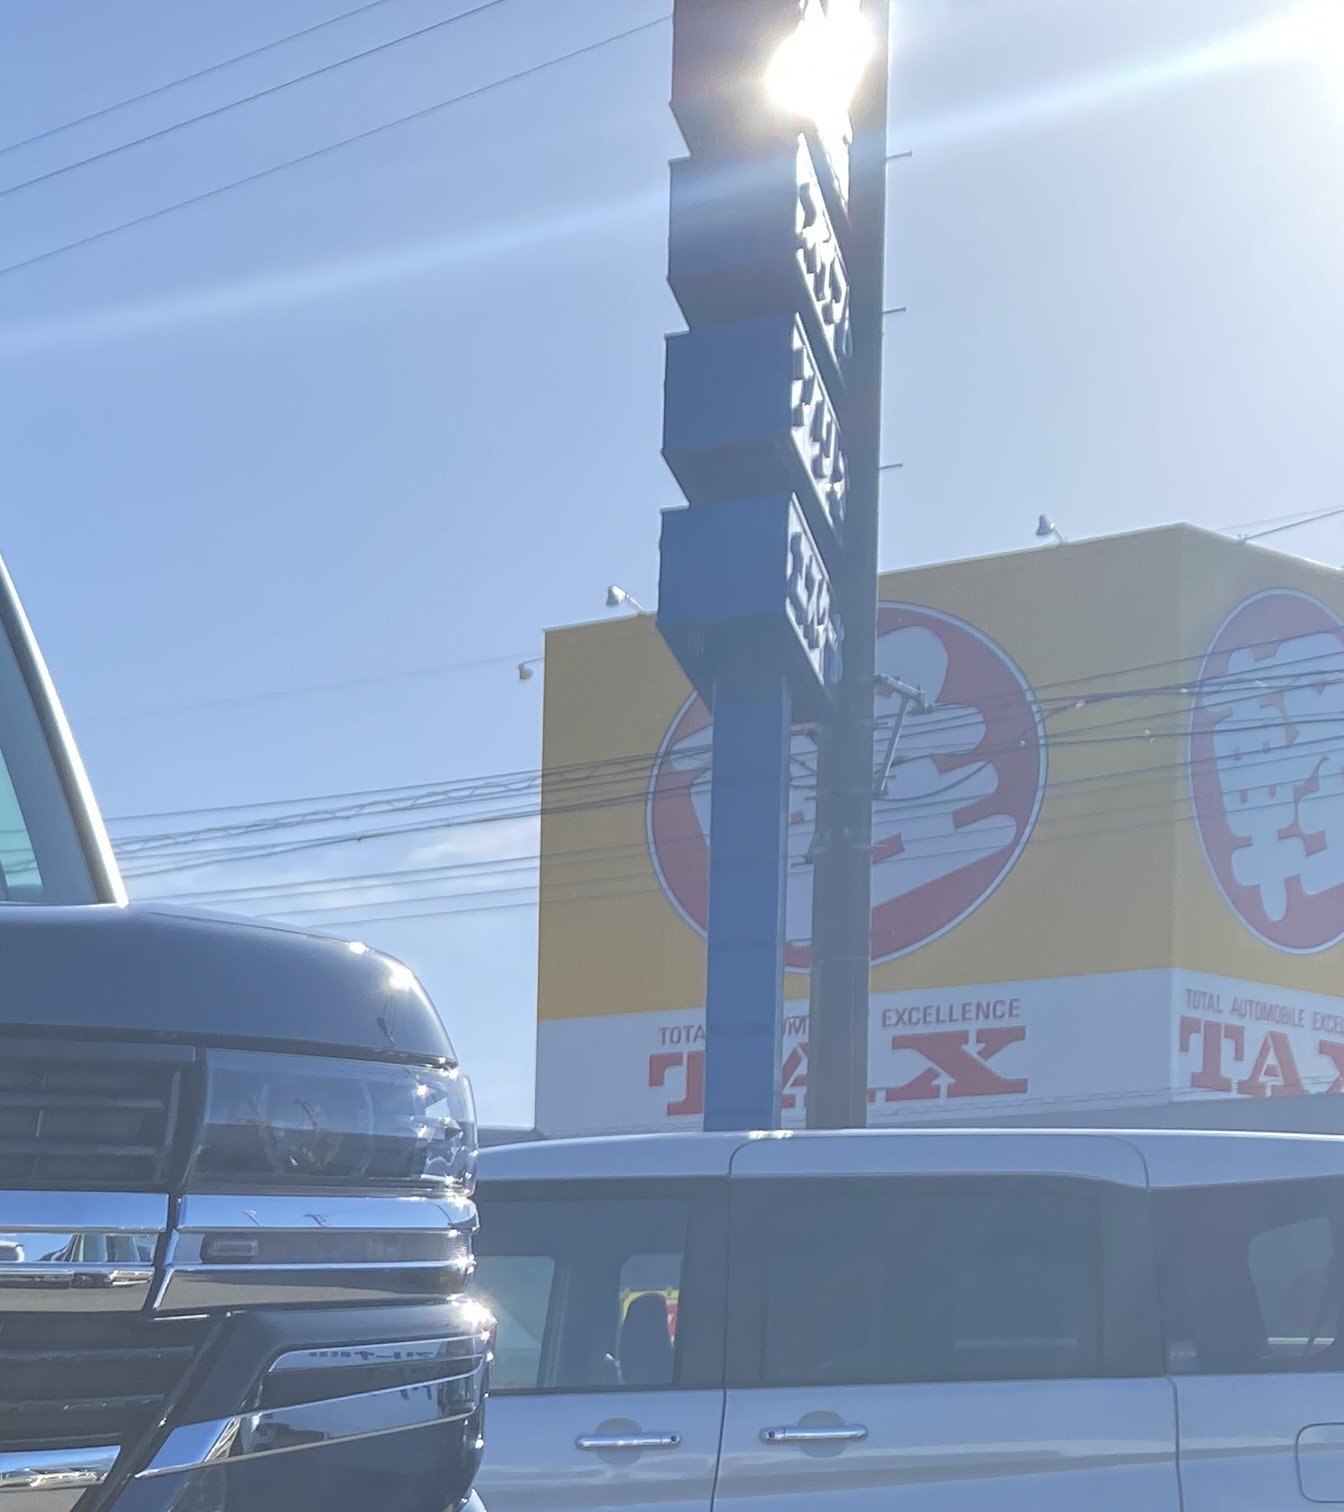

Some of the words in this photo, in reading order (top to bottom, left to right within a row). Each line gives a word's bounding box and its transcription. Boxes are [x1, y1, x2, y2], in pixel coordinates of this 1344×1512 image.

[658, 1023, 705, 1046] TOTA
[881, 998, 1022, 1029] EXCELLENCE
[1185, 988, 1223, 1014] TOTAL
[1230, 996, 1306, 1028] AUTOMOBILE
